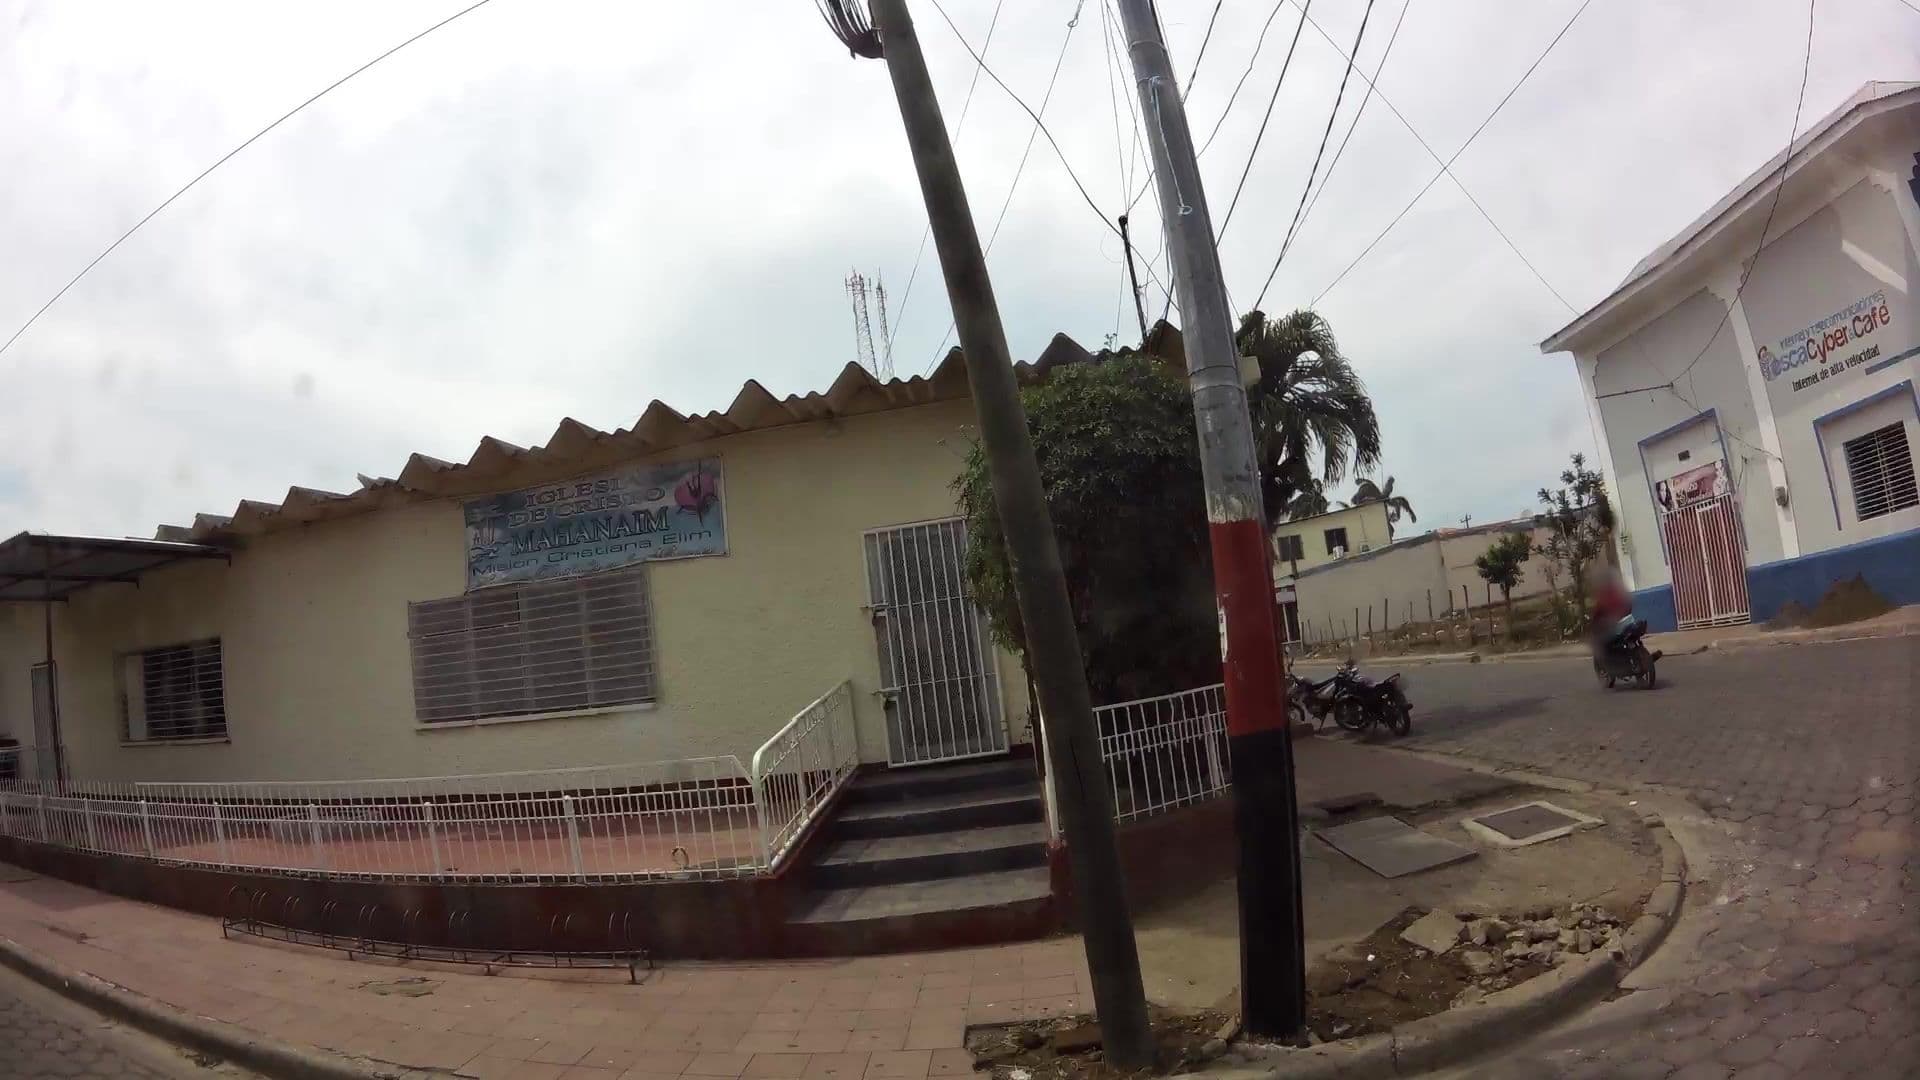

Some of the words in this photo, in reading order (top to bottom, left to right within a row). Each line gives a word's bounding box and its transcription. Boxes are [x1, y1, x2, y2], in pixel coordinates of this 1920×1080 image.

[1852, 299, 1891, 338] Café
[1792, 373, 1820, 393] Internet
[1829, 361, 1845, 376] alta
[1846, 344, 1881, 369] velocidad
[508, 507, 548, 528] DE
[511, 507, 670, 556] MAHANAIM
[548, 538, 652, 563] Cristiana
[662, 529, 712, 546] Elim
